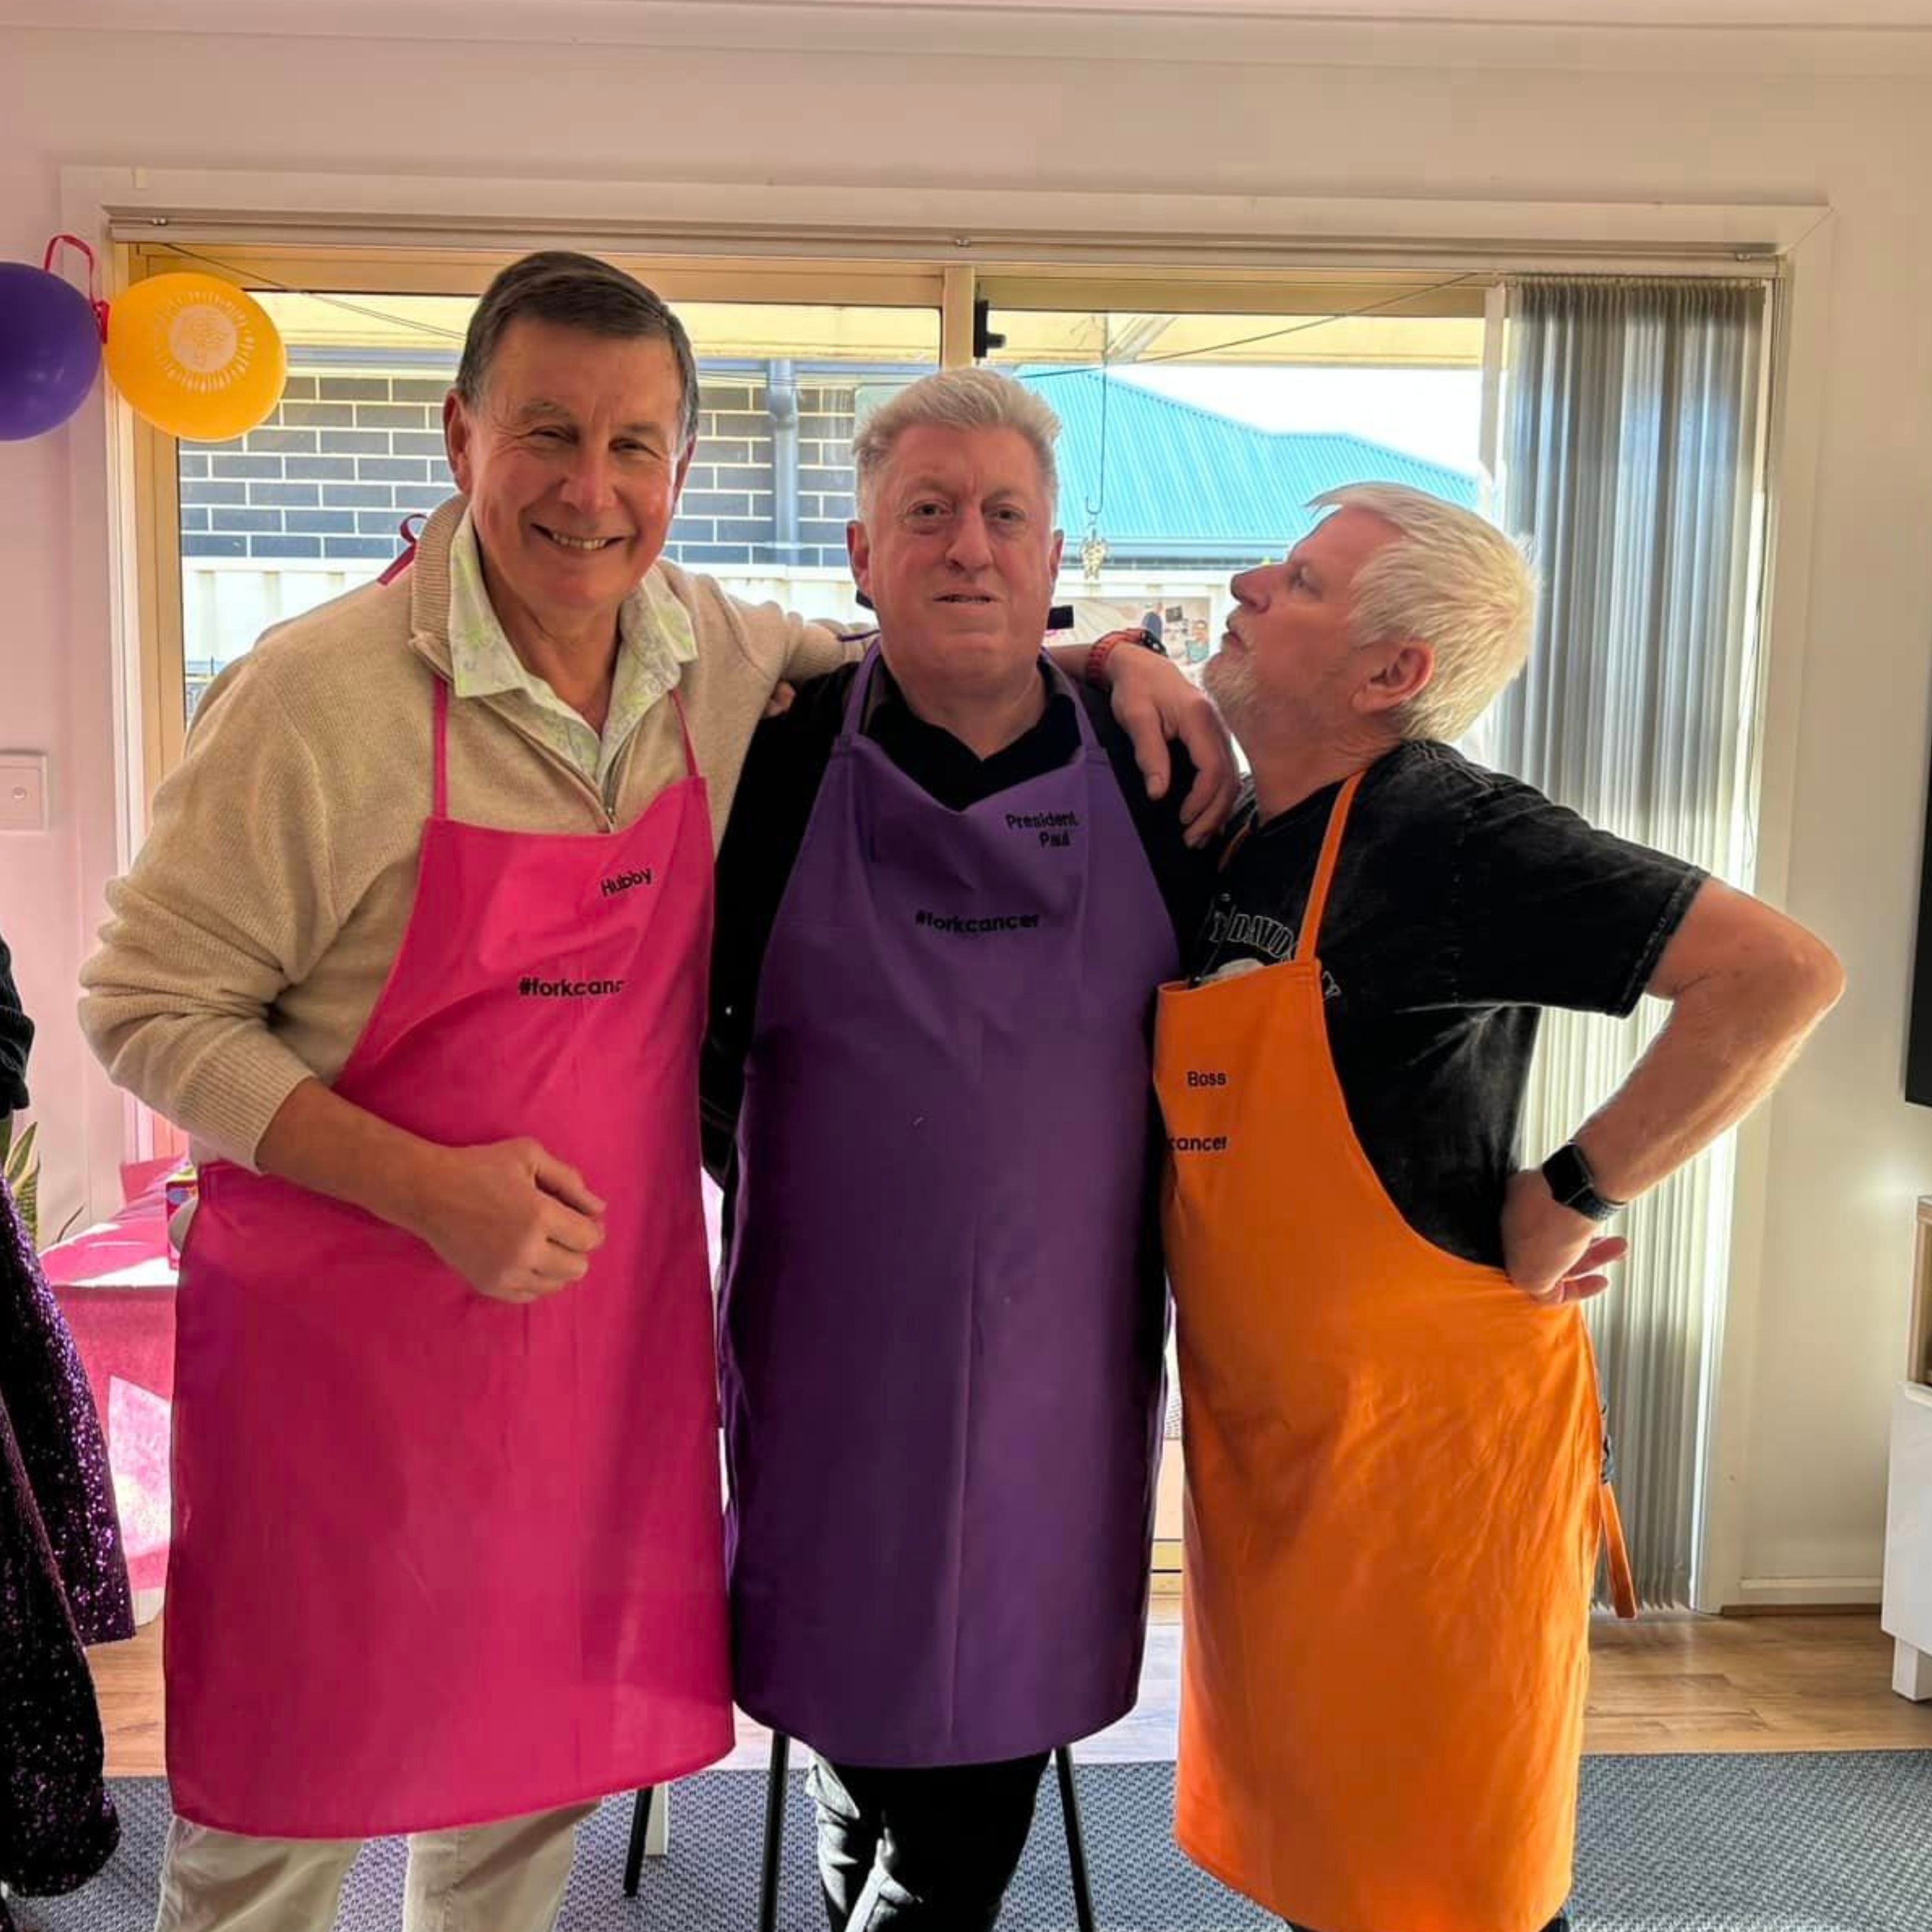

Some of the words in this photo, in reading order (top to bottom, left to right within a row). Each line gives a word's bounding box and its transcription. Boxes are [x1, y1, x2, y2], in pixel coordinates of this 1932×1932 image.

[1005, 811, 1079, 829] President
[1040, 830, 1070, 847] Paul
[601, 868, 651, 896] Hubby
[915, 910, 1040, 933] #forkcancer
[1187, 1071, 1227, 1087] Boss
